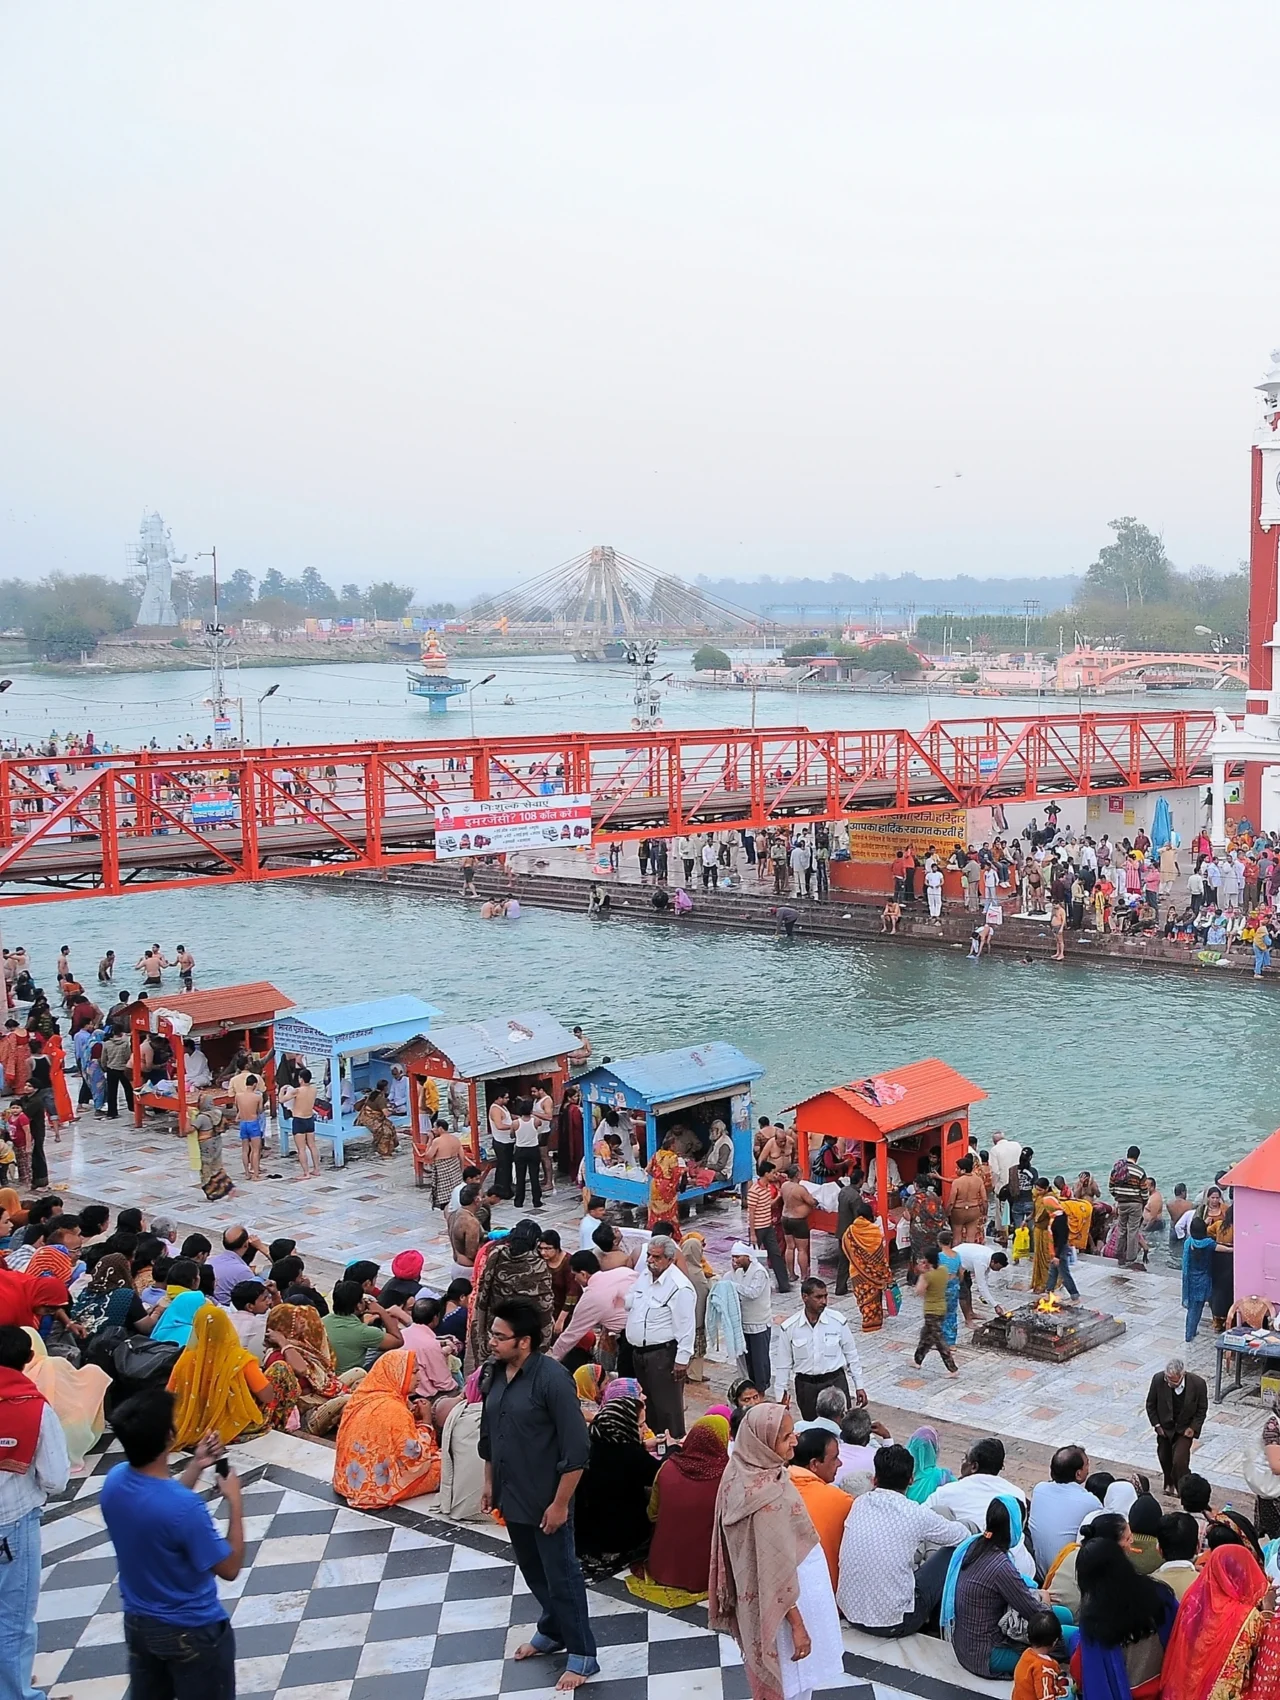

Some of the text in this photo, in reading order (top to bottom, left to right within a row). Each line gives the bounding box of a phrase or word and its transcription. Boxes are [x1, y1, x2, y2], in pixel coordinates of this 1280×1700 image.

[520, 810, 537, 821] 108
[540, 810, 557, 820] कॉल
[850, 822, 878, 832] आपका
[878, 822, 904, 834] हार्दिक
[904, 826, 932, 835] स्वागत
[933, 826, 957, 837] करती
[957, 827, 965, 839] है
